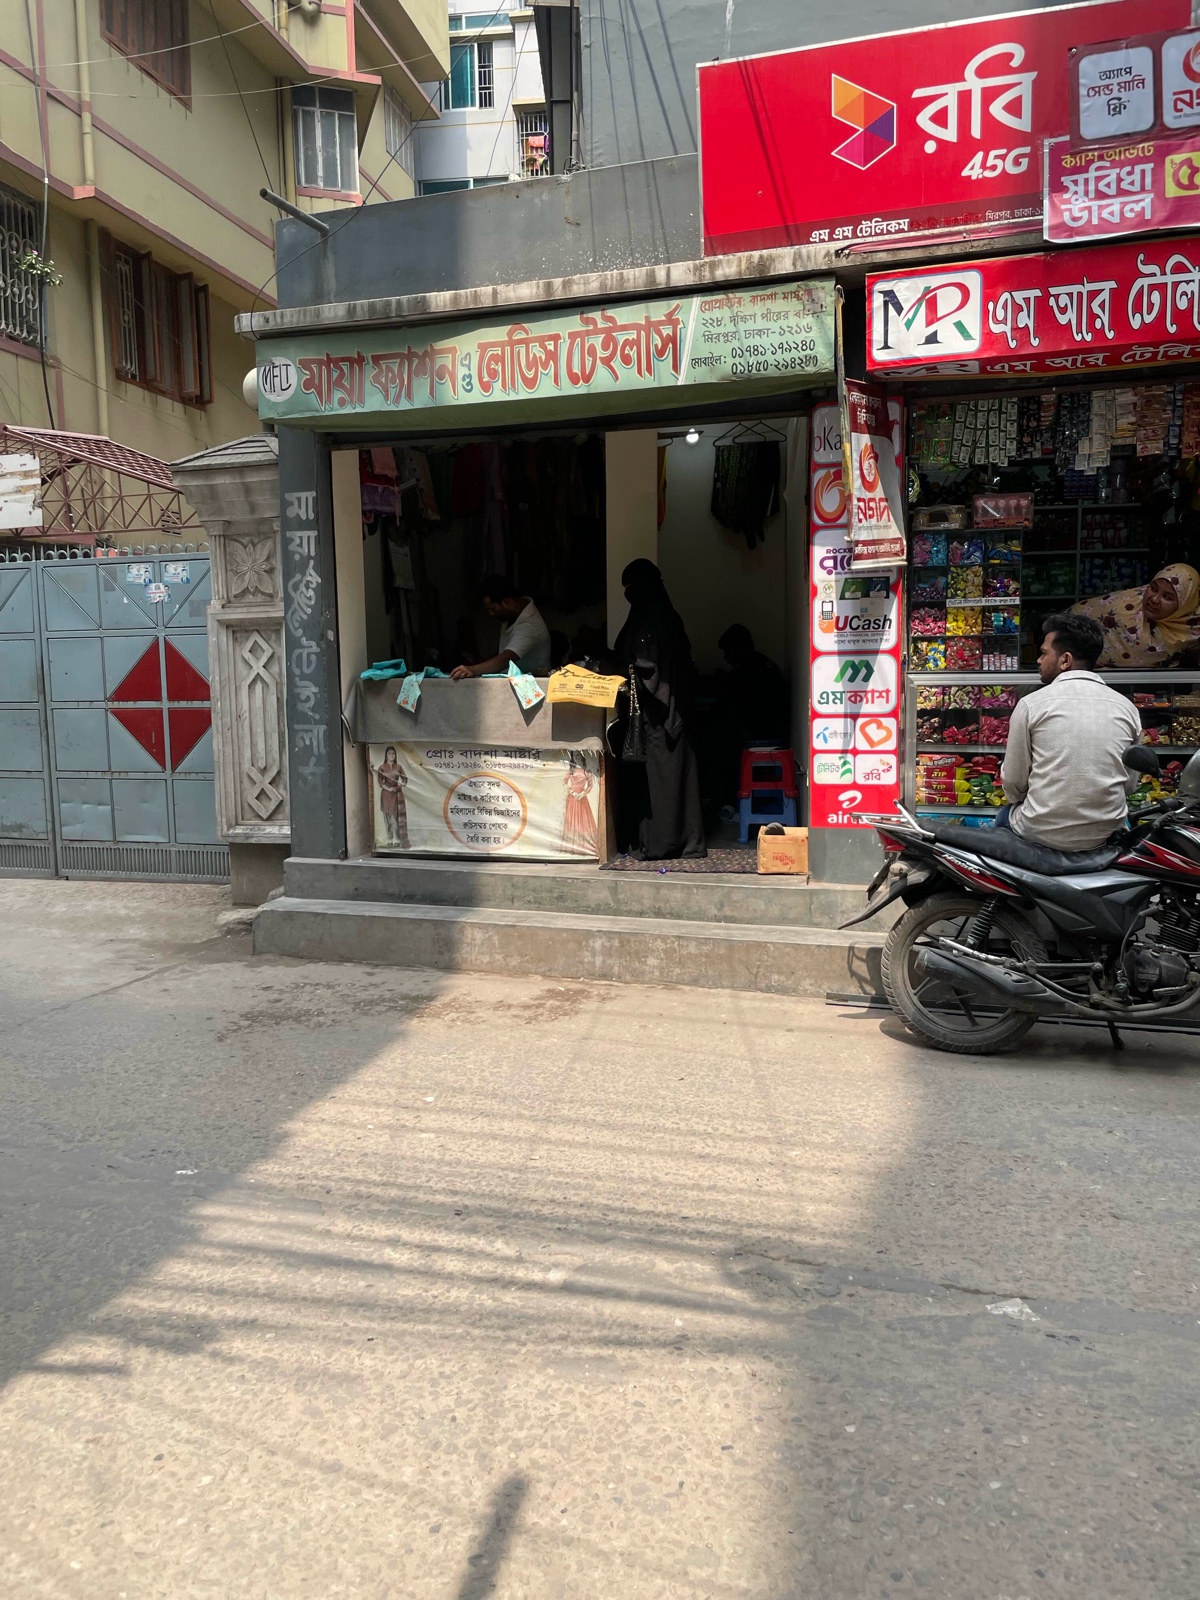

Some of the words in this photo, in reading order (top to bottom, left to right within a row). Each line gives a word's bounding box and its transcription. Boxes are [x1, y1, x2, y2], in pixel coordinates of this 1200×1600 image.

[1098, 66, 1133, 81] অ্যাপে
[1087, 83, 1114, 98] সেন্ড
[1117, 74, 1146, 94] মানি
[911, 43, 1038, 154] রবি
[1107, 97, 1127, 117] ফ্রি
[961, 147, 1031, 180] 4.5G
[1061, 152, 1098, 168] ক্যাশ
[1061, 161, 1154, 205] সুবিধা
[1061, 193, 1154, 227] ডাবল
[809, 229, 830, 243] এম
[833, 226, 853, 240] এম
[857, 218, 910, 237] টেলিকম
[988, 288, 1043, 349] এম
[1048, 275, 1118, 342] আর
[1127, 252, 1200, 335] টেলি
[702, 330, 739, 344] মিরপুর,
[297, 350, 369, 412] মায়া
[370, 343, 460, 407] ফ্যাশন
[476, 322, 564, 396] লেডিস
[565, 302, 686, 387] টেইলার্স
[1121, 343, 1200, 364] টেলি
[825, 547, 853, 555] ROCKE
[834, 614, 892, 631] UCash
[817, 690, 846, 705] এম
[846, 688, 891, 705] ক্যাশ
[426, 748, 454, 759] প্রোঃ
[460, 748, 498, 760] বাদশা
[862, 769, 881, 782] রবি
[481, 836, 491, 844] করা
